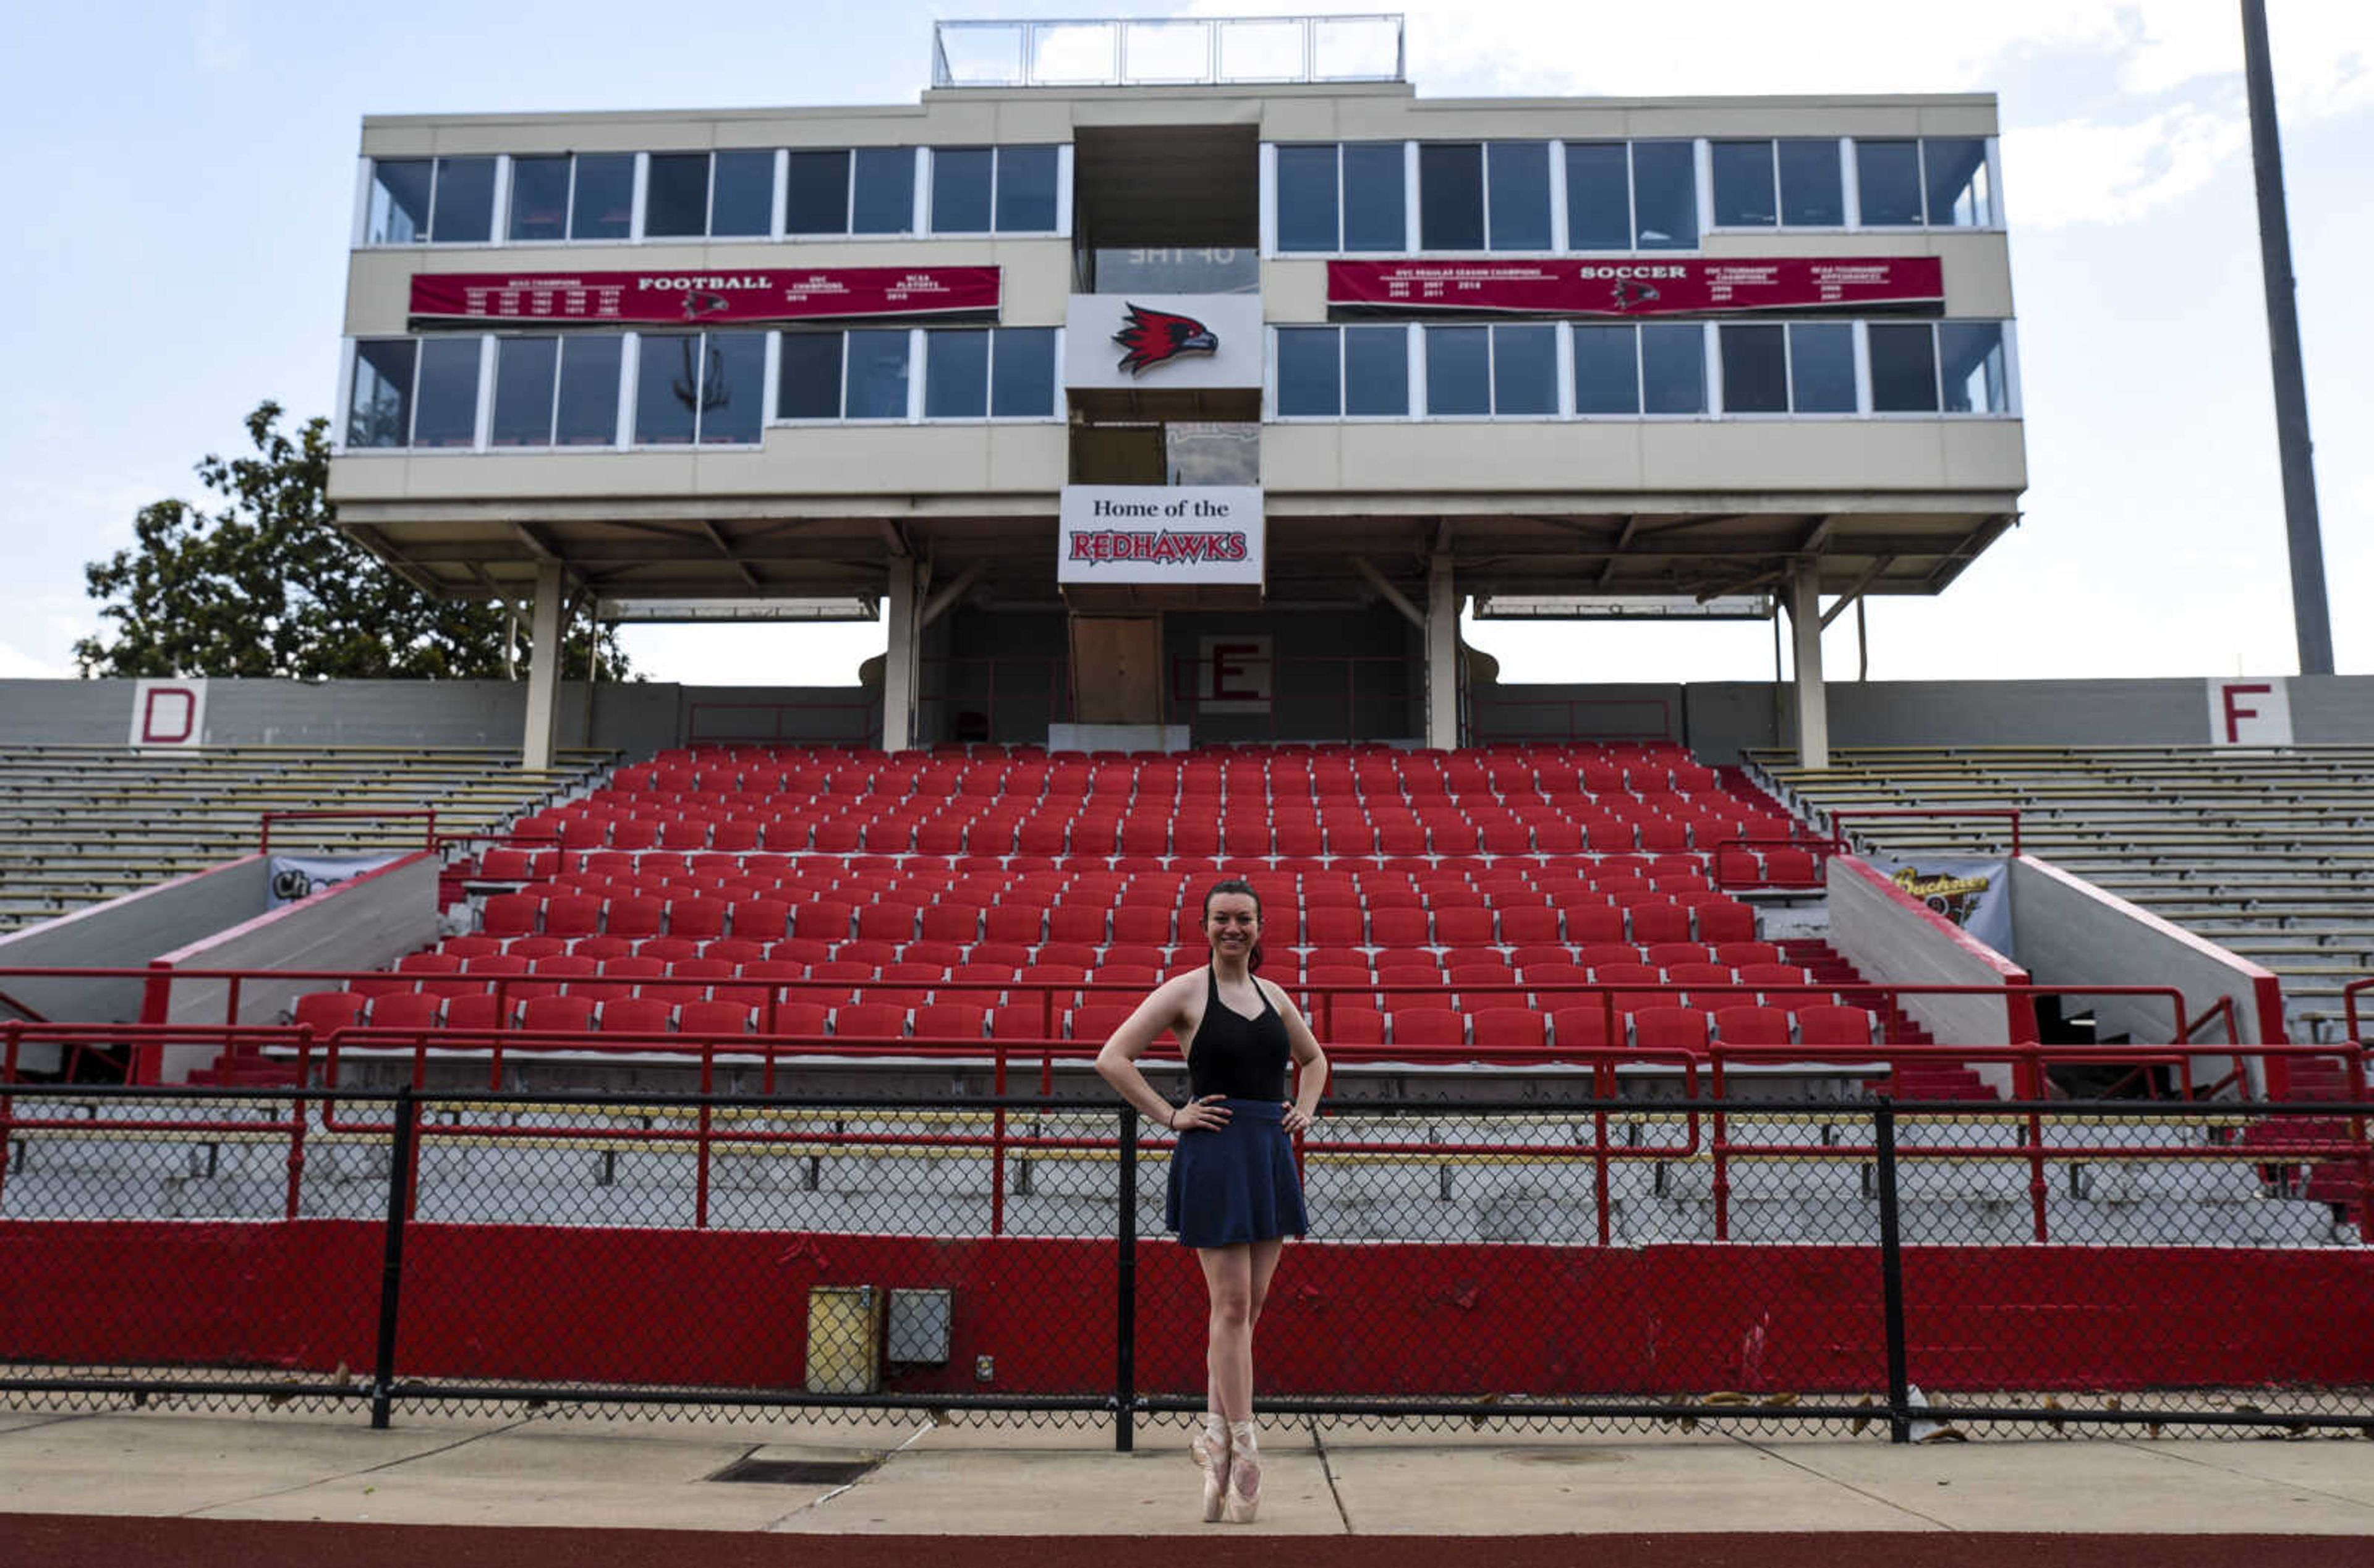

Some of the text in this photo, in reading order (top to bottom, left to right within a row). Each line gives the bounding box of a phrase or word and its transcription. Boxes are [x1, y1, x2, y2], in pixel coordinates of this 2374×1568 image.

[639, 278, 772, 290] FOOTBALL
[1580, 266, 1687, 279] SOCCER
[1094, 499, 1229, 517] Home of the
[1069, 529, 1247, 567] REDHAWKS
[1214, 644, 1259, 700] E
[143, 689, 195, 743] D
[2223, 684, 2271, 743] F
